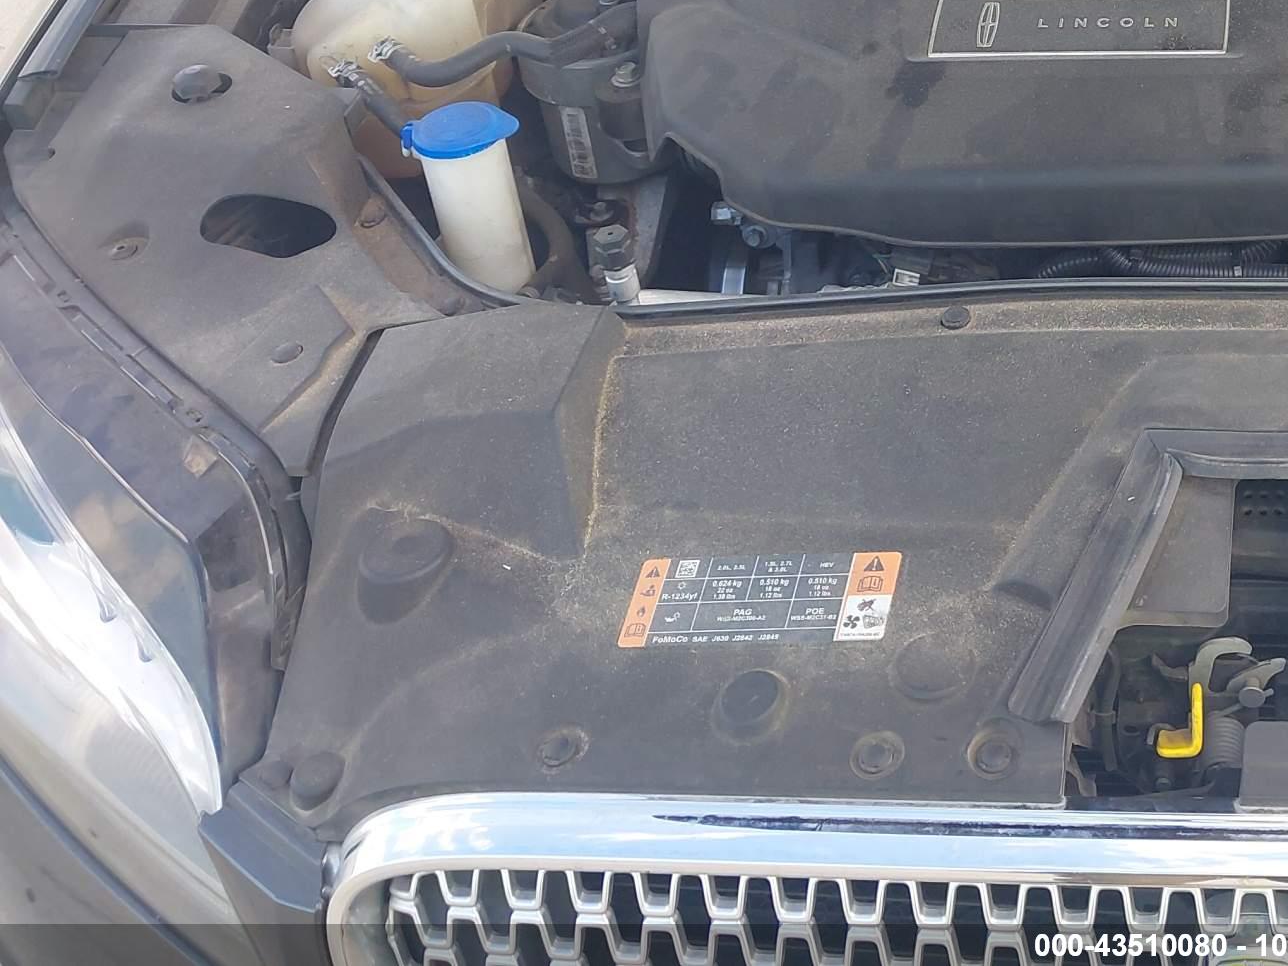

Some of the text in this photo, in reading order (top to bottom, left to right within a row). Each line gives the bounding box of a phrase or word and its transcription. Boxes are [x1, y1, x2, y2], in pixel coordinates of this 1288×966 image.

[1036, 16, 1178, 28] LINCOLN
[732, 580, 743, 588] kg
[780, 578, 790, 586] kg
[828, 577, 838, 585] kg
[661, 592, 698, 601] R-1234yf
[652, 635, 688, 643] FoMoCo
